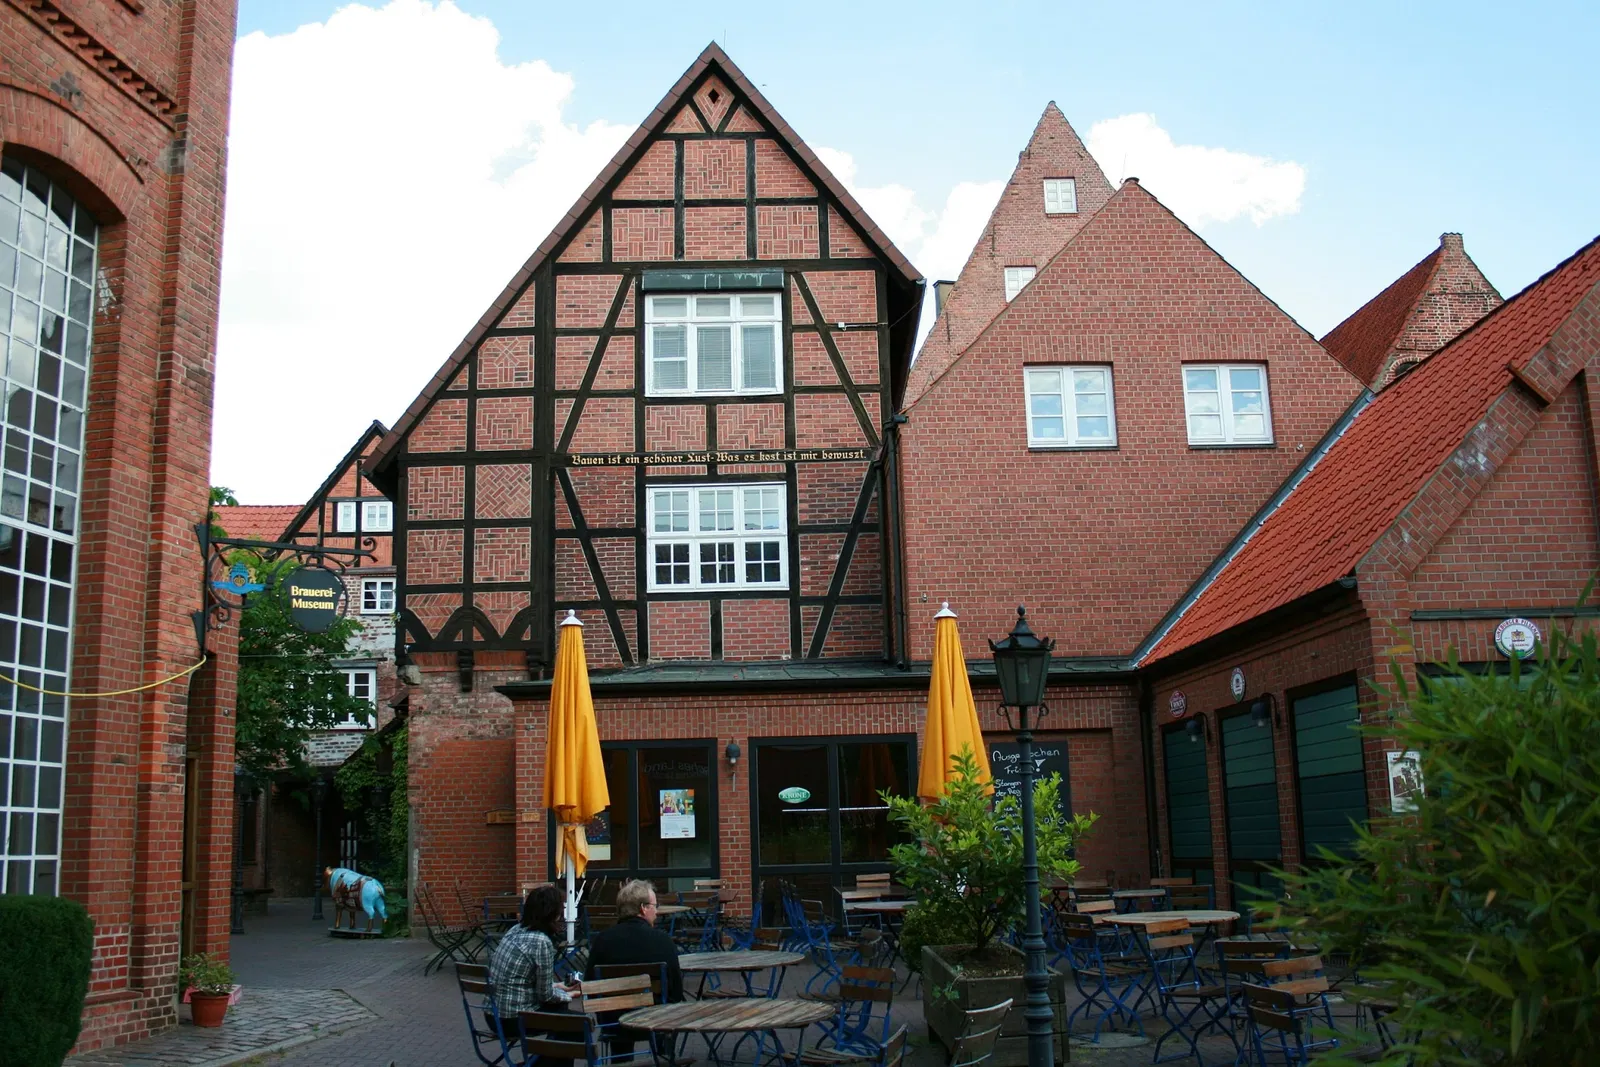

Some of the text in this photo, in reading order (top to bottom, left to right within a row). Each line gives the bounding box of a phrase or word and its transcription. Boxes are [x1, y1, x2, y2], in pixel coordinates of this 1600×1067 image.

[572, 455, 604, 465] Bauen
[608, 455, 621, 464] ist
[625, 454, 640, 464] ein
[643, 453, 683, 464] schöner
[744, 453, 755, 461] es
[759, 452, 780, 461] kost
[784, 451, 798, 460] ist
[800, 450, 818, 460] mir
[291, 585, 336, 597] Brauerei-
[292, 598, 334, 610] Museum
[782, 791, 808, 799] KRONE
